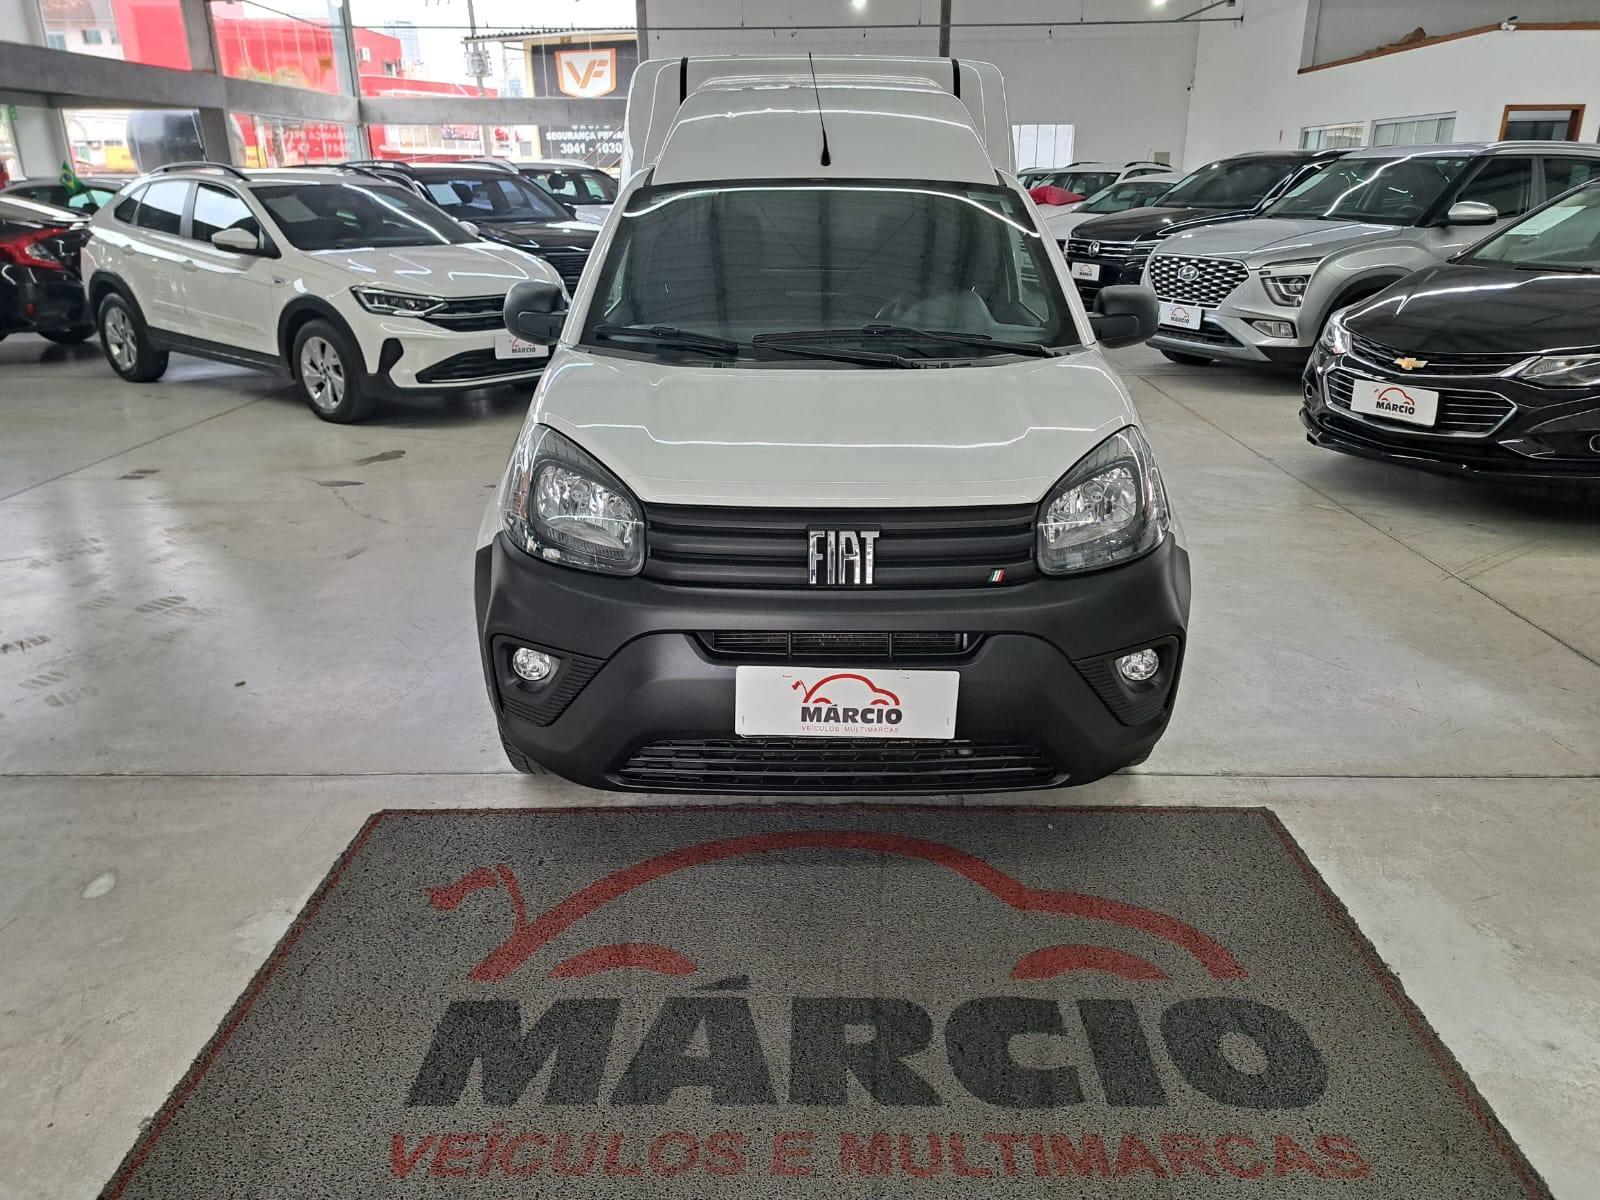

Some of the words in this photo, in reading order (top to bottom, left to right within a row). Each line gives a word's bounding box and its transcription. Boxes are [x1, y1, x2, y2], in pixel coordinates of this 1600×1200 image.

[565, 60, 608, 88] VF
[545, 131, 597, 142] SEGURANÇA
[560, 142, 586, 154] 3041
[808, 530, 880, 585] FIAT
[801, 704, 903, 725] MÁRCIO
[844, 725, 899, 733] MULTIMARCAS
[406, 974, 1328, 1108] MÁRCIO
[391, 1122, 747, 1178] VEÍCULOS
[771, 1131, 813, 1177] E
[838, 1132, 1372, 1181] MULTIMARCAS
